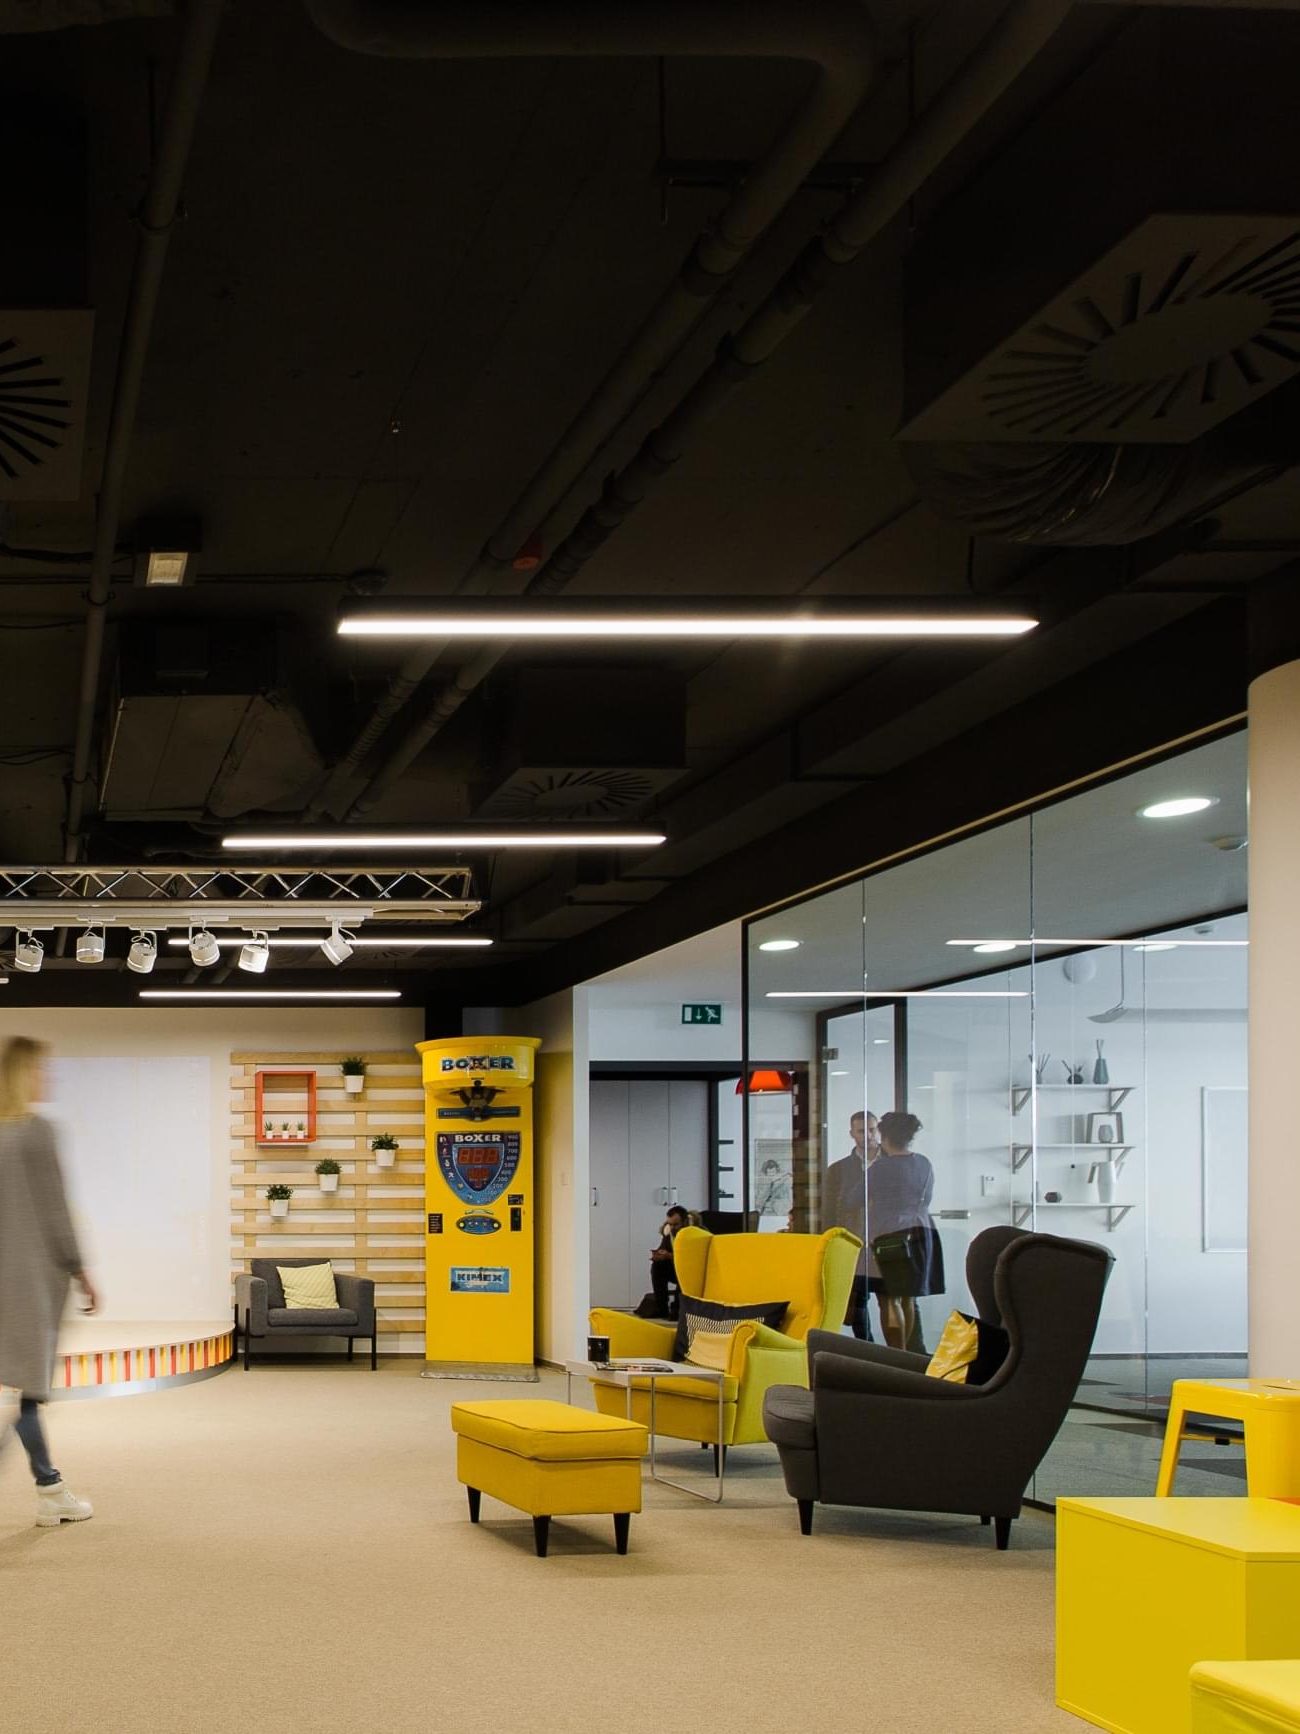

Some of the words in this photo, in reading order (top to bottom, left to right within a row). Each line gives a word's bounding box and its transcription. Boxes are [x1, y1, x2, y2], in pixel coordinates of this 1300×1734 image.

[441, 1056, 516, 1072] BOXER
[455, 1134, 501, 1143] BOXER
[456, 1272, 503, 1283] KIMEX
